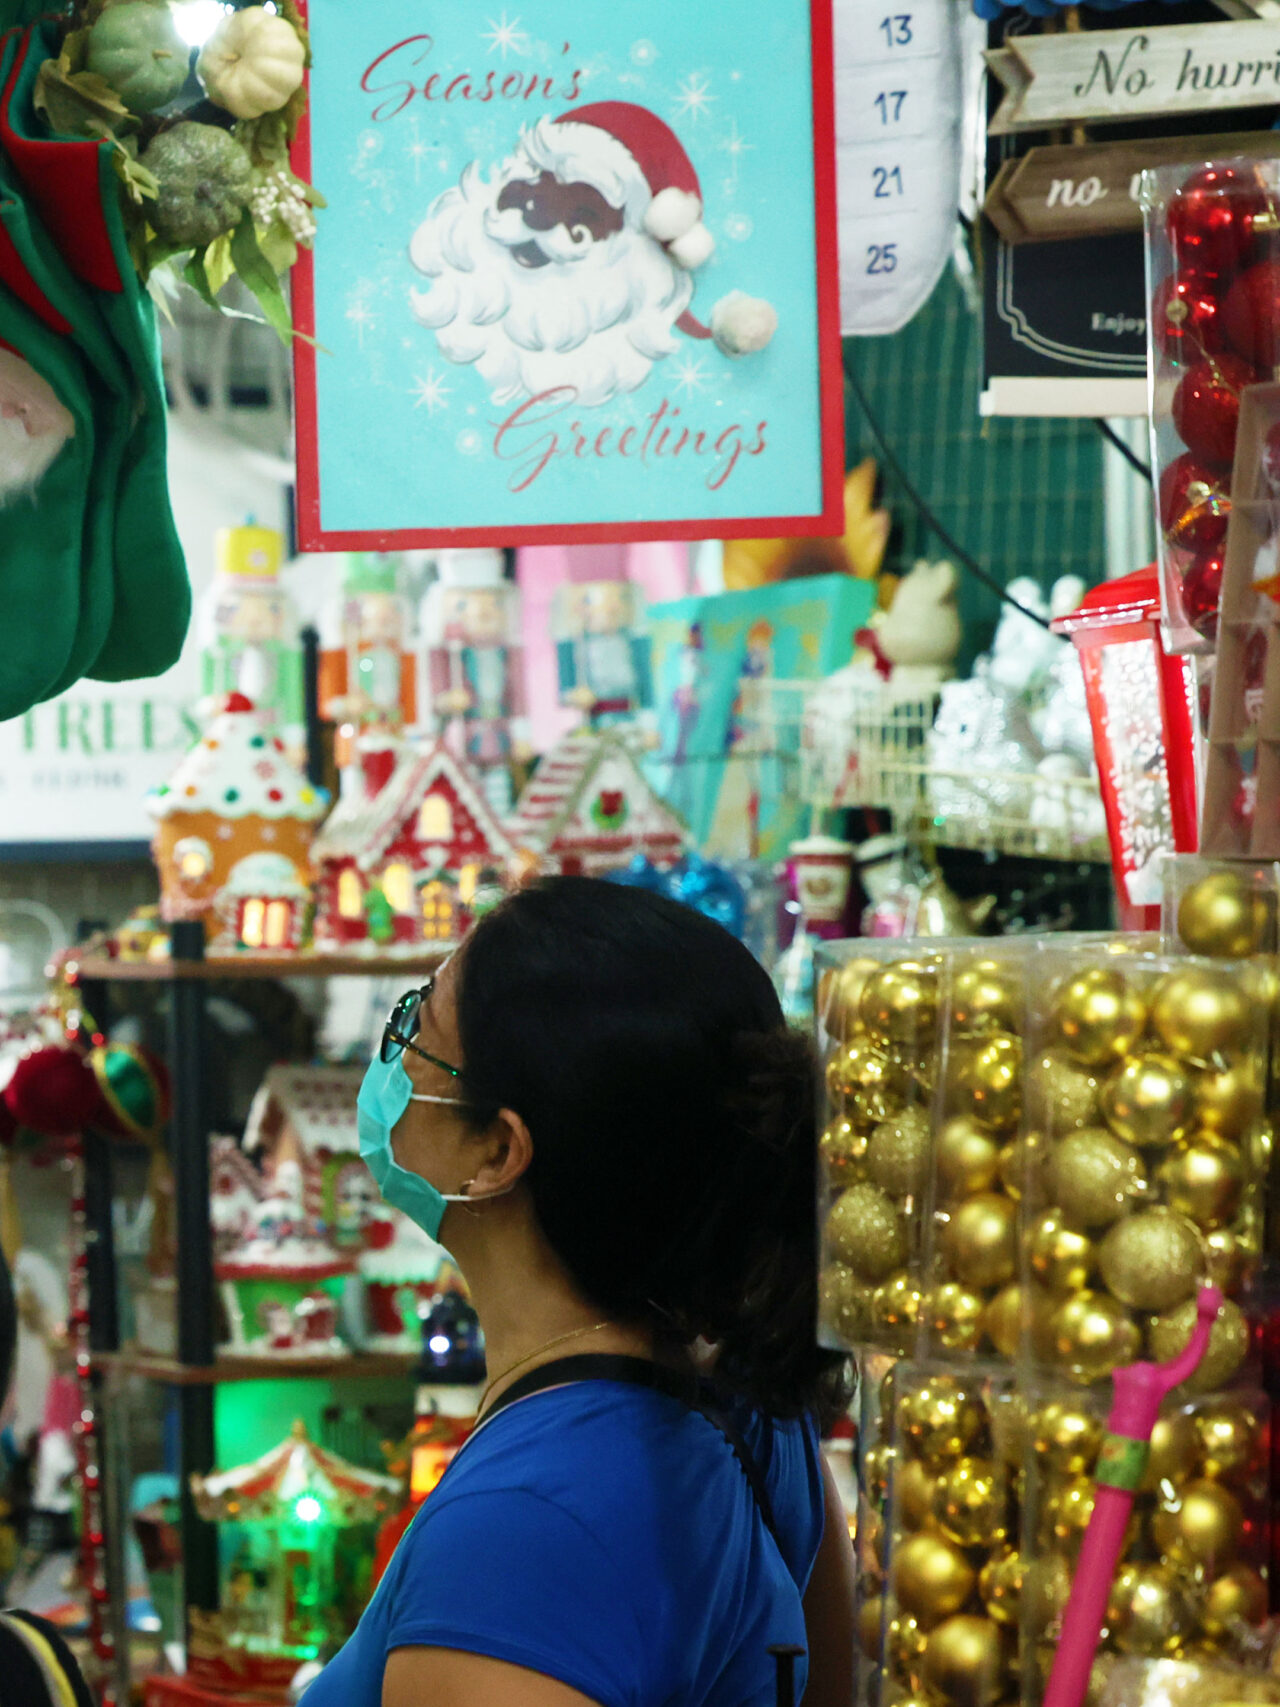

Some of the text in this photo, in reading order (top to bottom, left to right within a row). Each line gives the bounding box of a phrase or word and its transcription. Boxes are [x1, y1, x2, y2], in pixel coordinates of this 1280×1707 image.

[878, 13, 914, 48] 13
[360, 33, 582, 123] Season's
[1073, 33, 1154, 98] No
[873, 89, 908, 126] 17
[872, 164, 904, 199] 21
[1045, 175, 1110, 209] no
[865, 242, 898, 275] 25
[487, 384, 768, 493] Greetings
